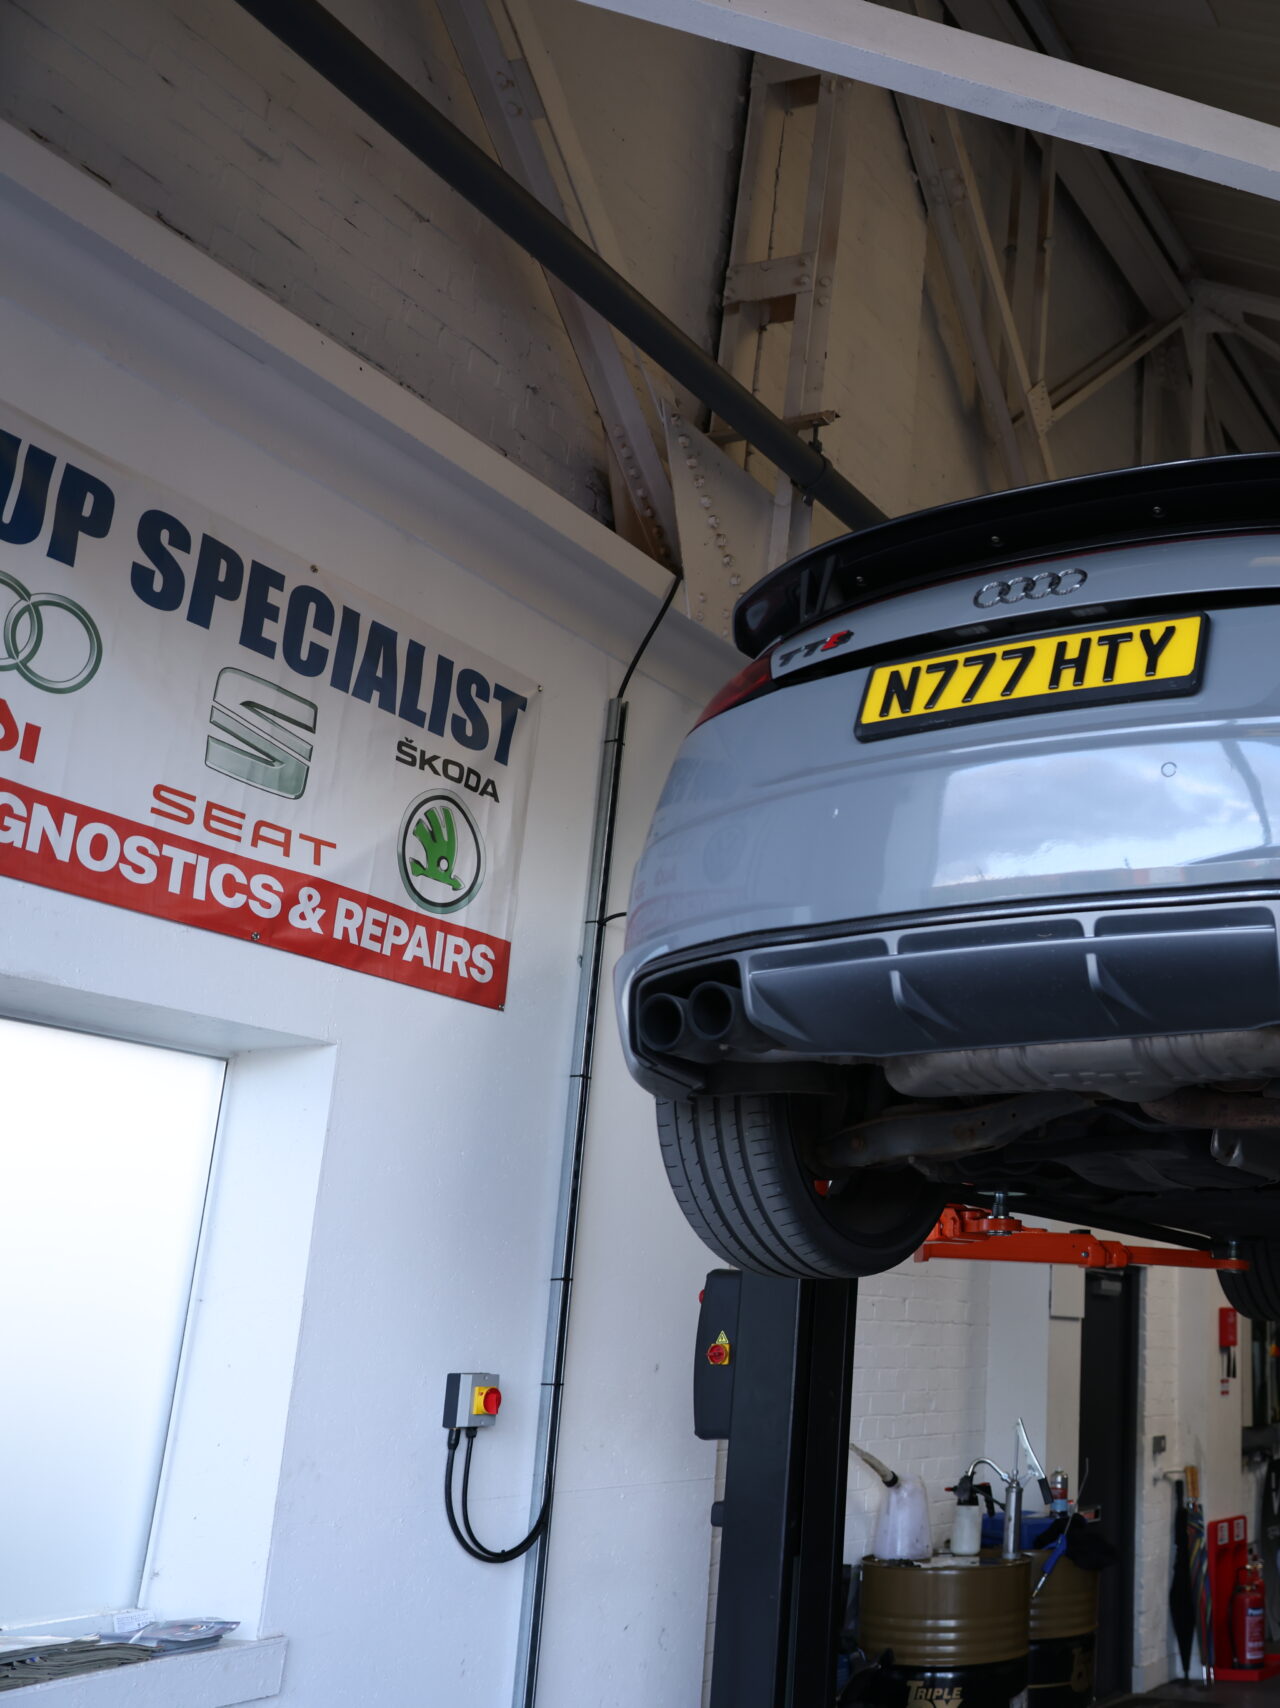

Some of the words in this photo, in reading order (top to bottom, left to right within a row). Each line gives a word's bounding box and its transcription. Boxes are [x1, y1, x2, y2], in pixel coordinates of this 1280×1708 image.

[130, 508, 529, 768] SPECIALIST
[878, 645, 1037, 718] N777
[1047, 625, 1177, 690] HTY
[395, 736, 500, 803] ŠKODA
[149, 783, 338, 867] SEAT
[288, 885, 326, 937] &
[332, 897, 497, 985] REPAIRS
[906, 1680, 963, 1700] TRIPLE
